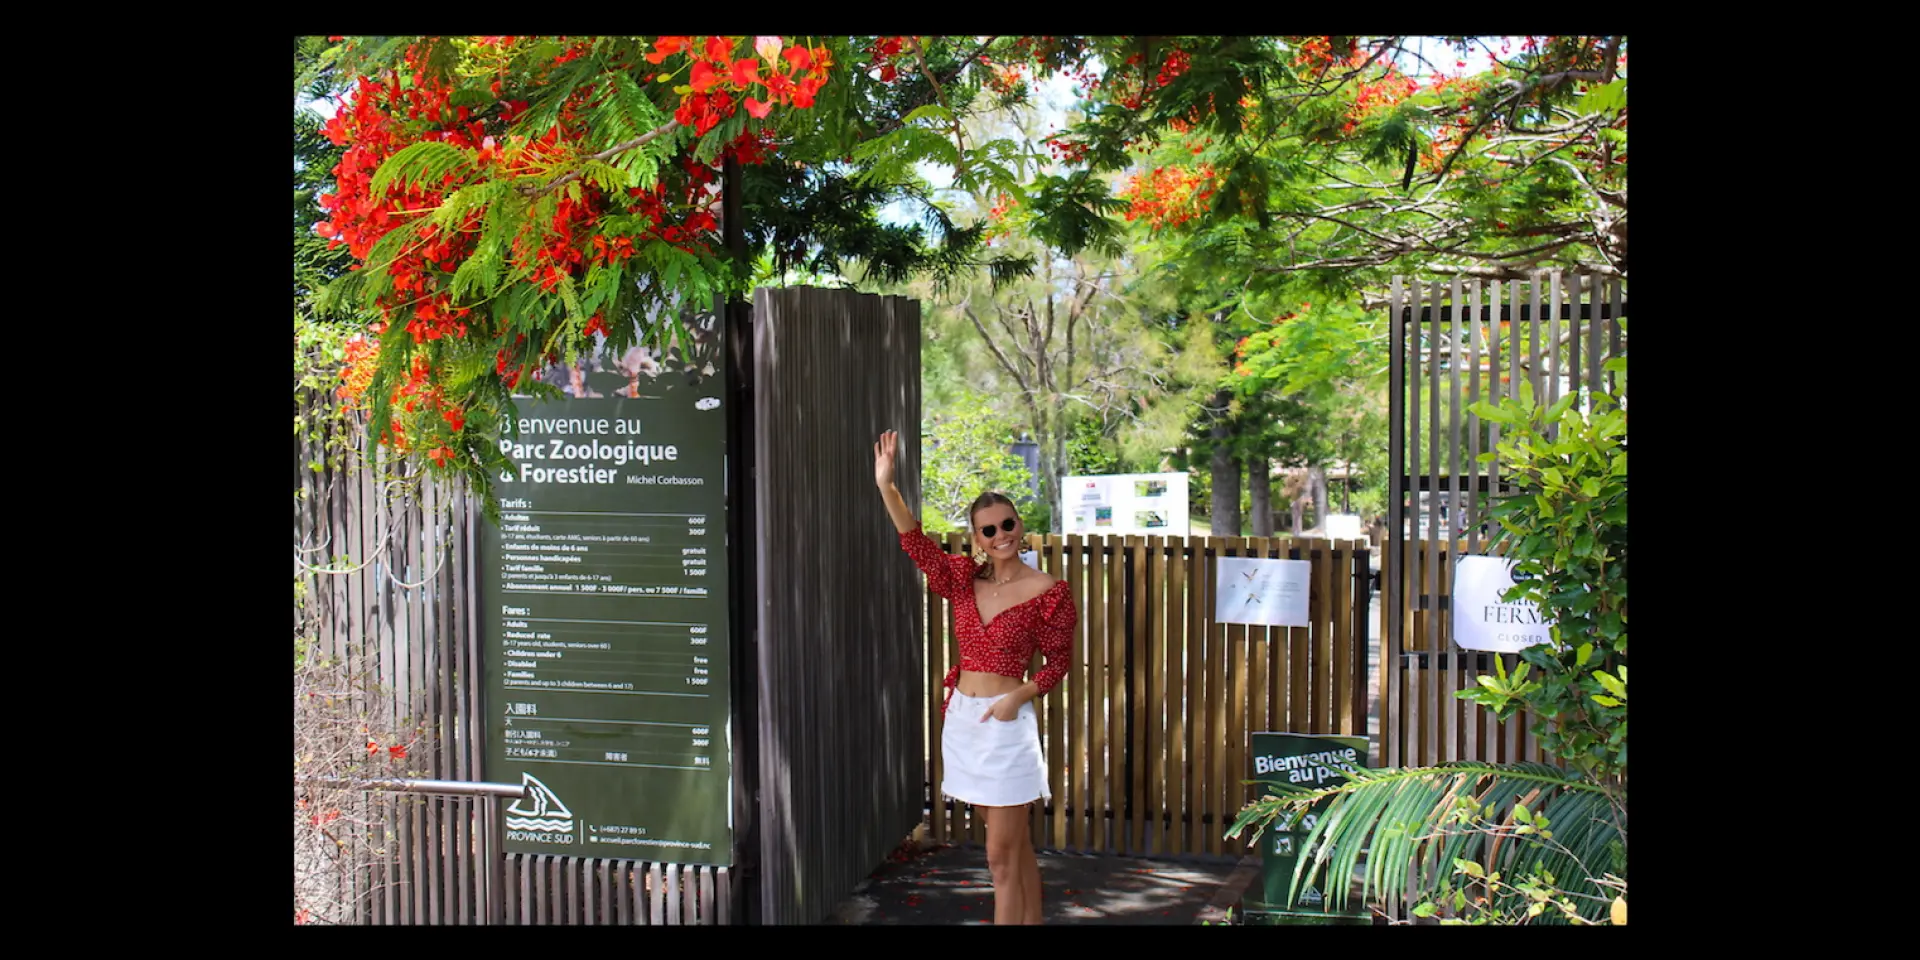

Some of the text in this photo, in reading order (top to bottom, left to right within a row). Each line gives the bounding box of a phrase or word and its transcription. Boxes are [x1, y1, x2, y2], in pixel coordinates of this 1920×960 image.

[499, 413, 641, 434] Benvenue au
[499, 439, 678, 465] Parc Zoologique
[520, 462, 617, 484] Forestier
[626, 475, 656, 485] Michel
[657, 476, 704, 486] Corbasson
[500, 498, 526, 509] Tarifs
[688, 517, 705, 525] 600F
[688, 528, 705, 536] 300F
[505, 543, 530, 551] Enfants
[531, 543, 539, 551] de
[682, 548, 706, 556] gratuit
[505, 553, 706, 566] Personnes handicapées gratuit
[505, 564, 520, 572] Tarif
[521, 564, 544, 572] famille
[506, 582, 549, 590] Abonnement
[549, 583, 573, 591] annuel
[580, 584, 597, 592] 500F
[627, 586, 645, 594] pers.
[683, 587, 708, 595] famille
[502, 605, 526, 616] Fares
[1484, 606, 1553, 624] FERM
[689, 626, 707, 634] 600F
[506, 631, 535, 639] Reduced
[690, 637, 707, 645] 300F
[1497, 632, 1543, 643] CLOSED
[693, 656, 708, 664] free
[507, 660, 708, 675] Disabled free
[691, 677, 708, 685] 500F
[692, 727, 709, 735] 600F
[692, 738, 709, 747] 300F
[1254, 747, 1356, 775] Bienvenue
[1289, 767, 1314, 783] au
[506, 830, 573, 844] PROVINCE SUD
